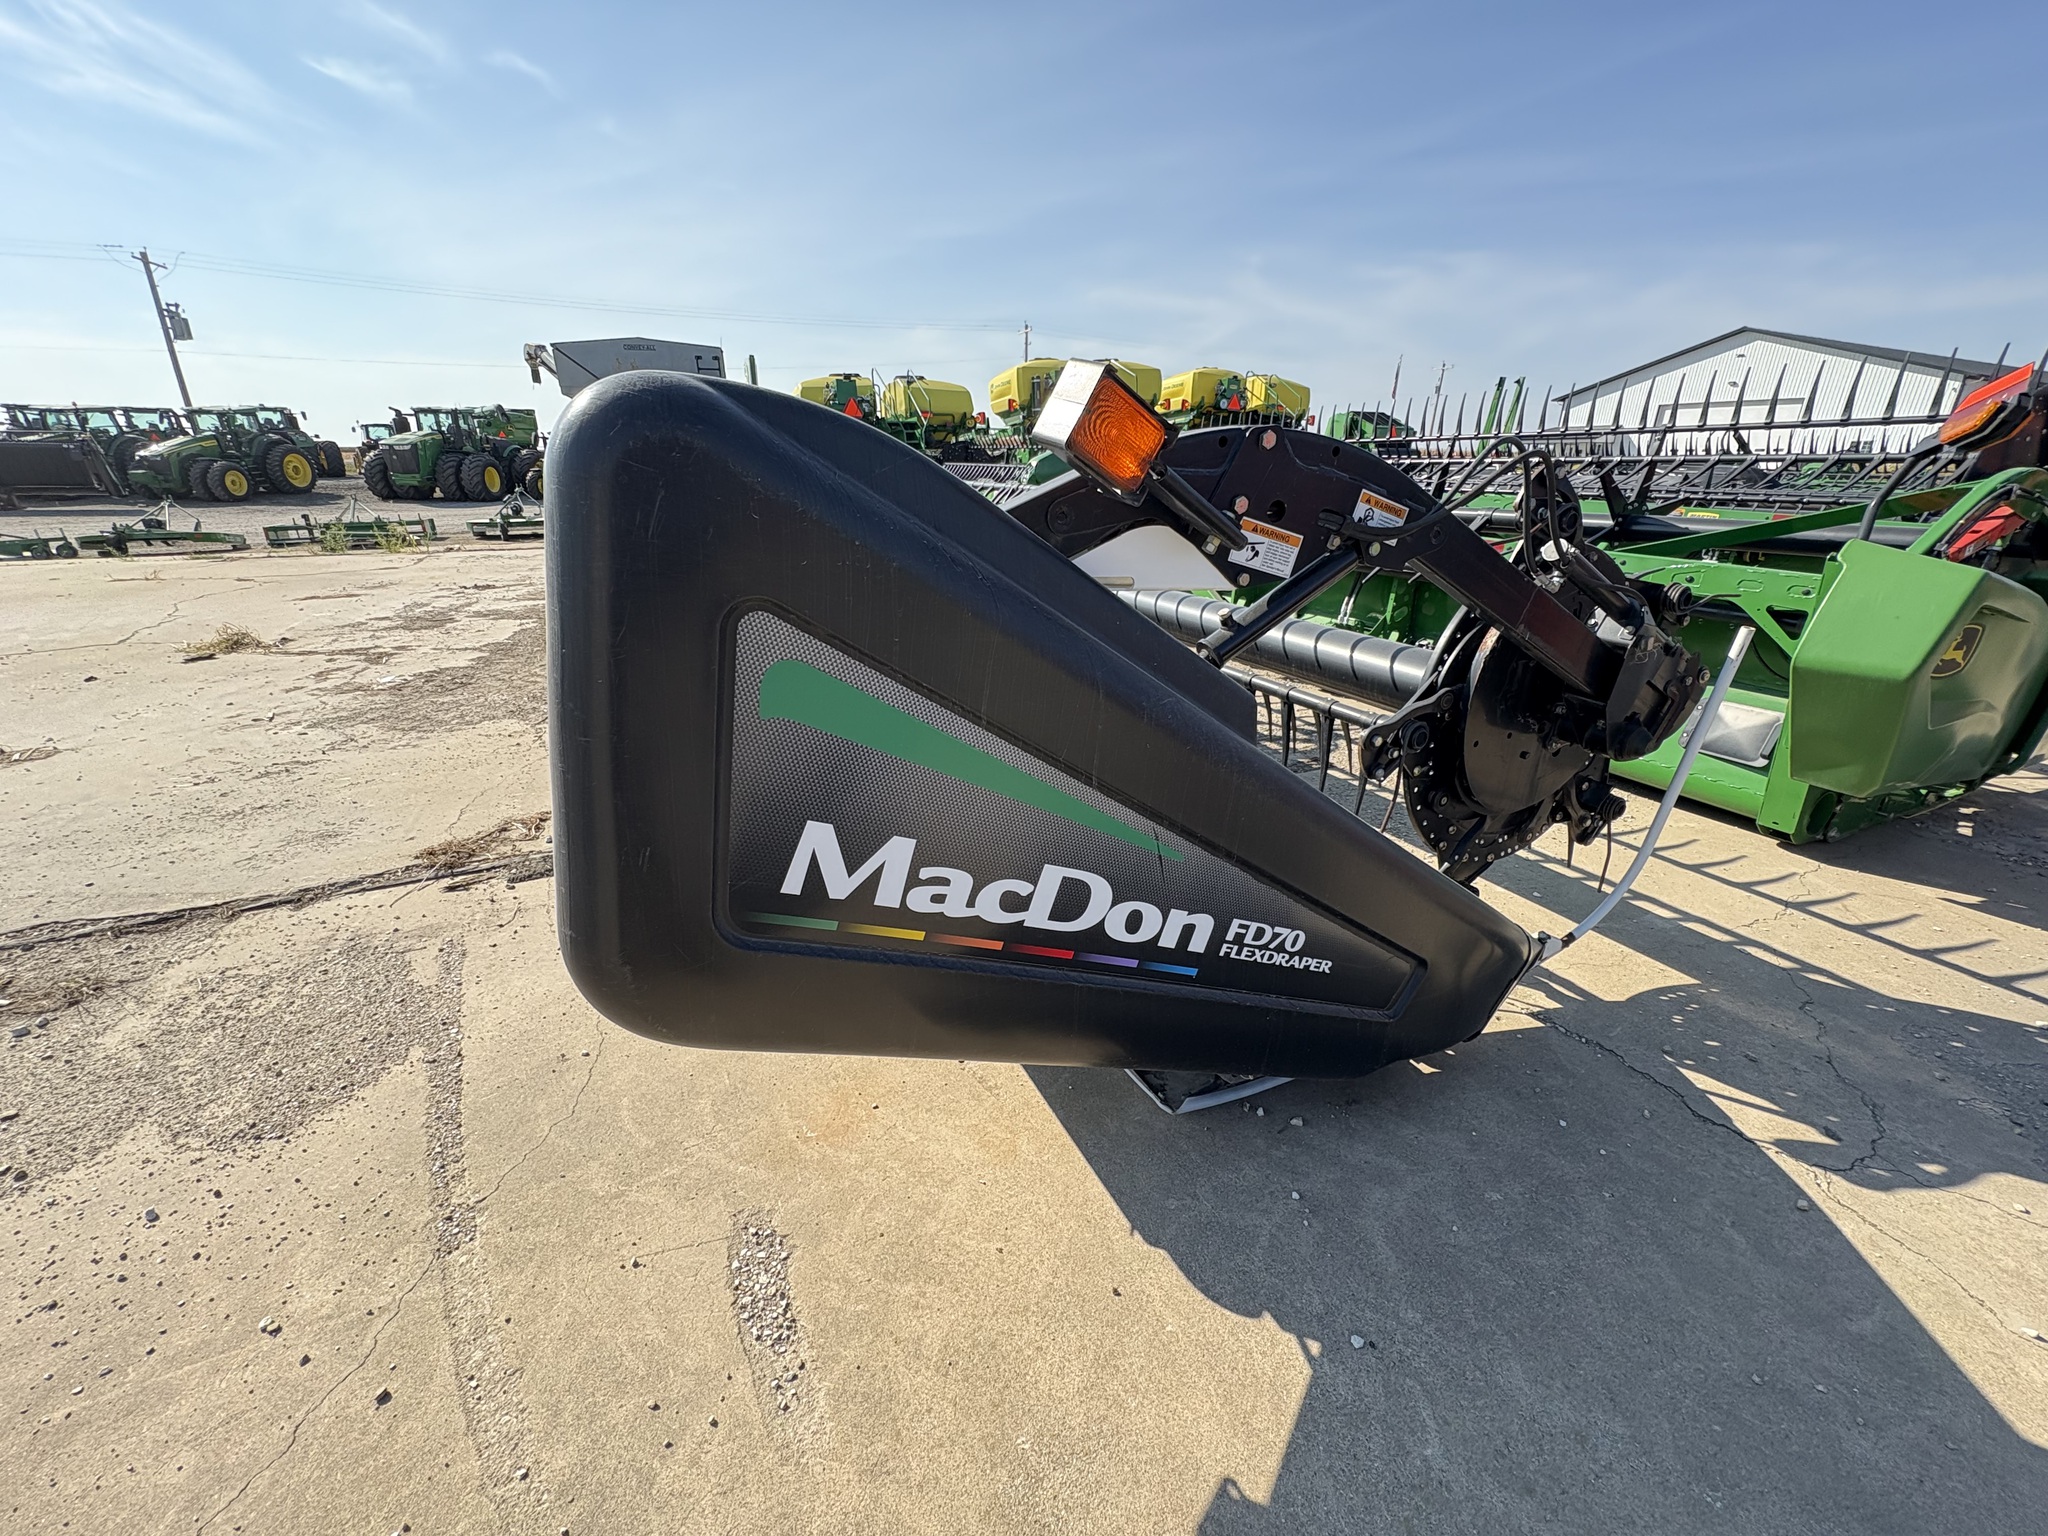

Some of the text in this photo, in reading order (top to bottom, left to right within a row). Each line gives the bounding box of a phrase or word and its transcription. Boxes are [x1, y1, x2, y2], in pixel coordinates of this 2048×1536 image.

[1374, 499, 1403, 517] WARNING
[1260, 527, 1291, 543] WARNING
[780, 820, 1215, 952] MacDon
[1225, 918, 1306, 952] FD70
[1218, 943, 1333, 974] FLEXDRAPER
